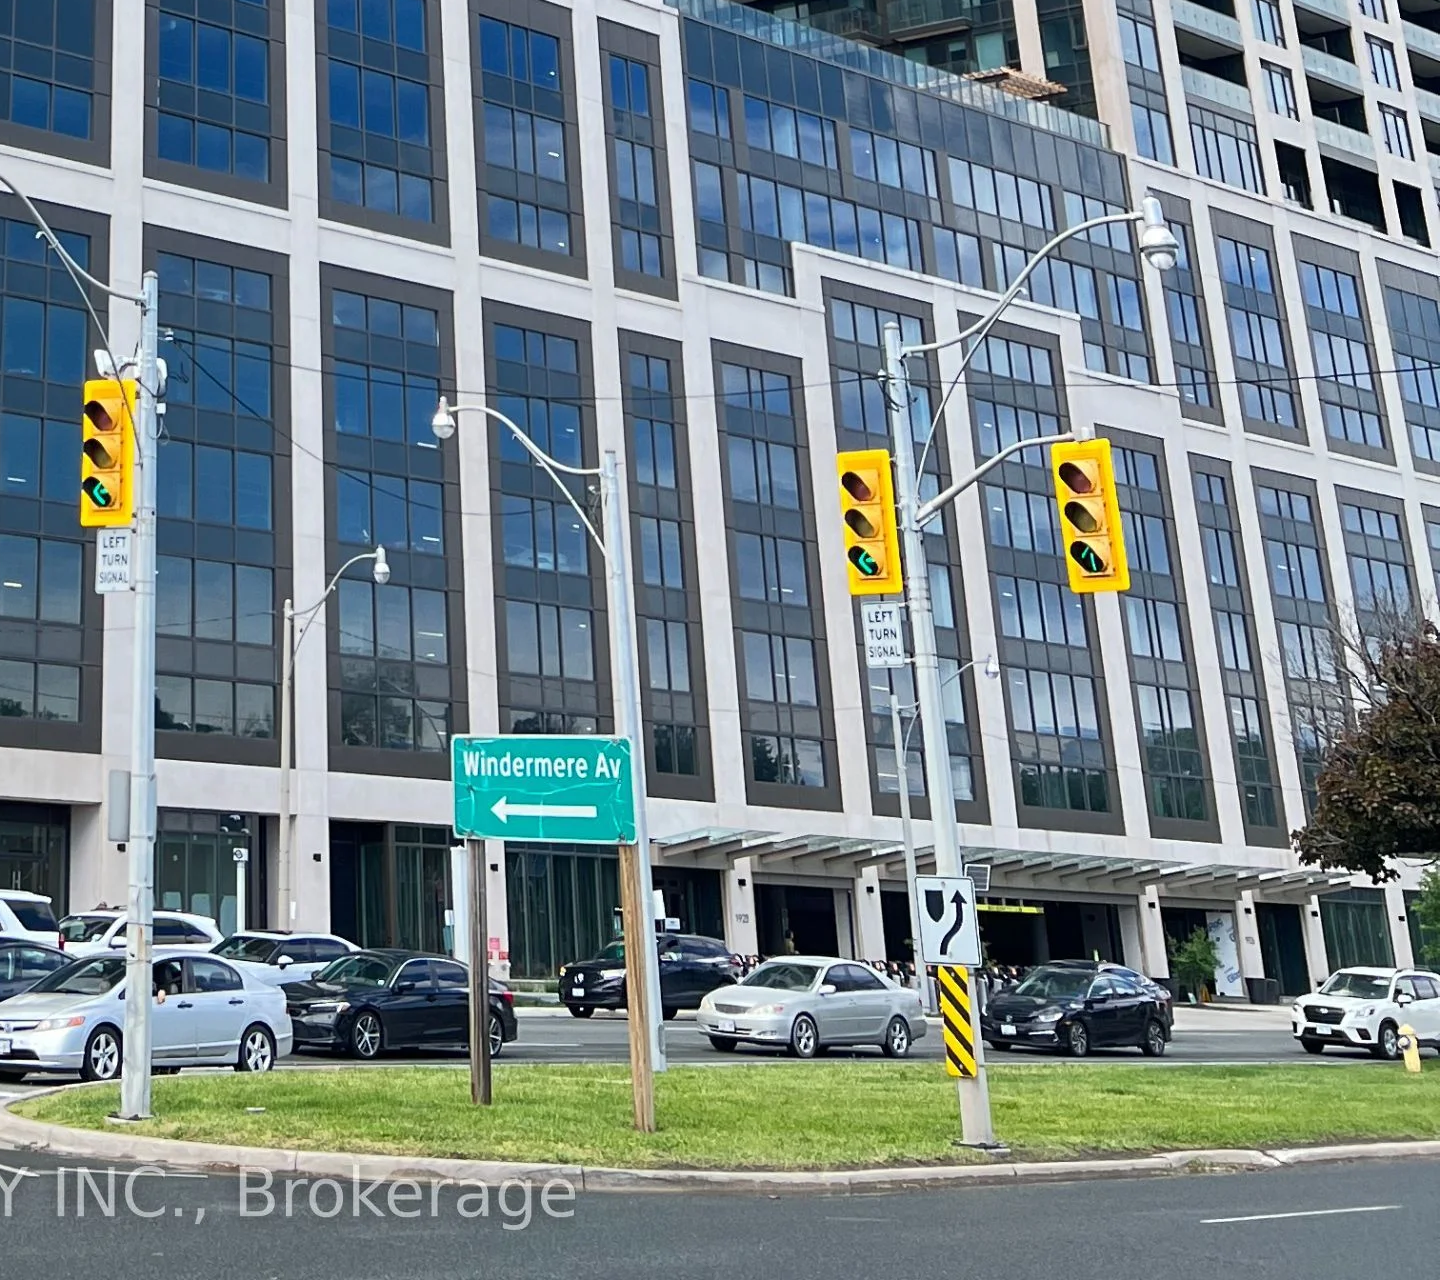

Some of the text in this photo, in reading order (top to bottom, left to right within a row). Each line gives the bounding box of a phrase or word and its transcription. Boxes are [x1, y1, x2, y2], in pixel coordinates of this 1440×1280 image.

[103, 536, 126, 548] LEFT
[102, 554, 128, 566] TURN
[100, 571, 128, 584] SIGNAL
[868, 611, 892, 623] LEFT
[869, 628, 897, 640] TURN
[869, 645, 901, 658] SIGNAL
[463, 750, 621, 779] Windermere Av
